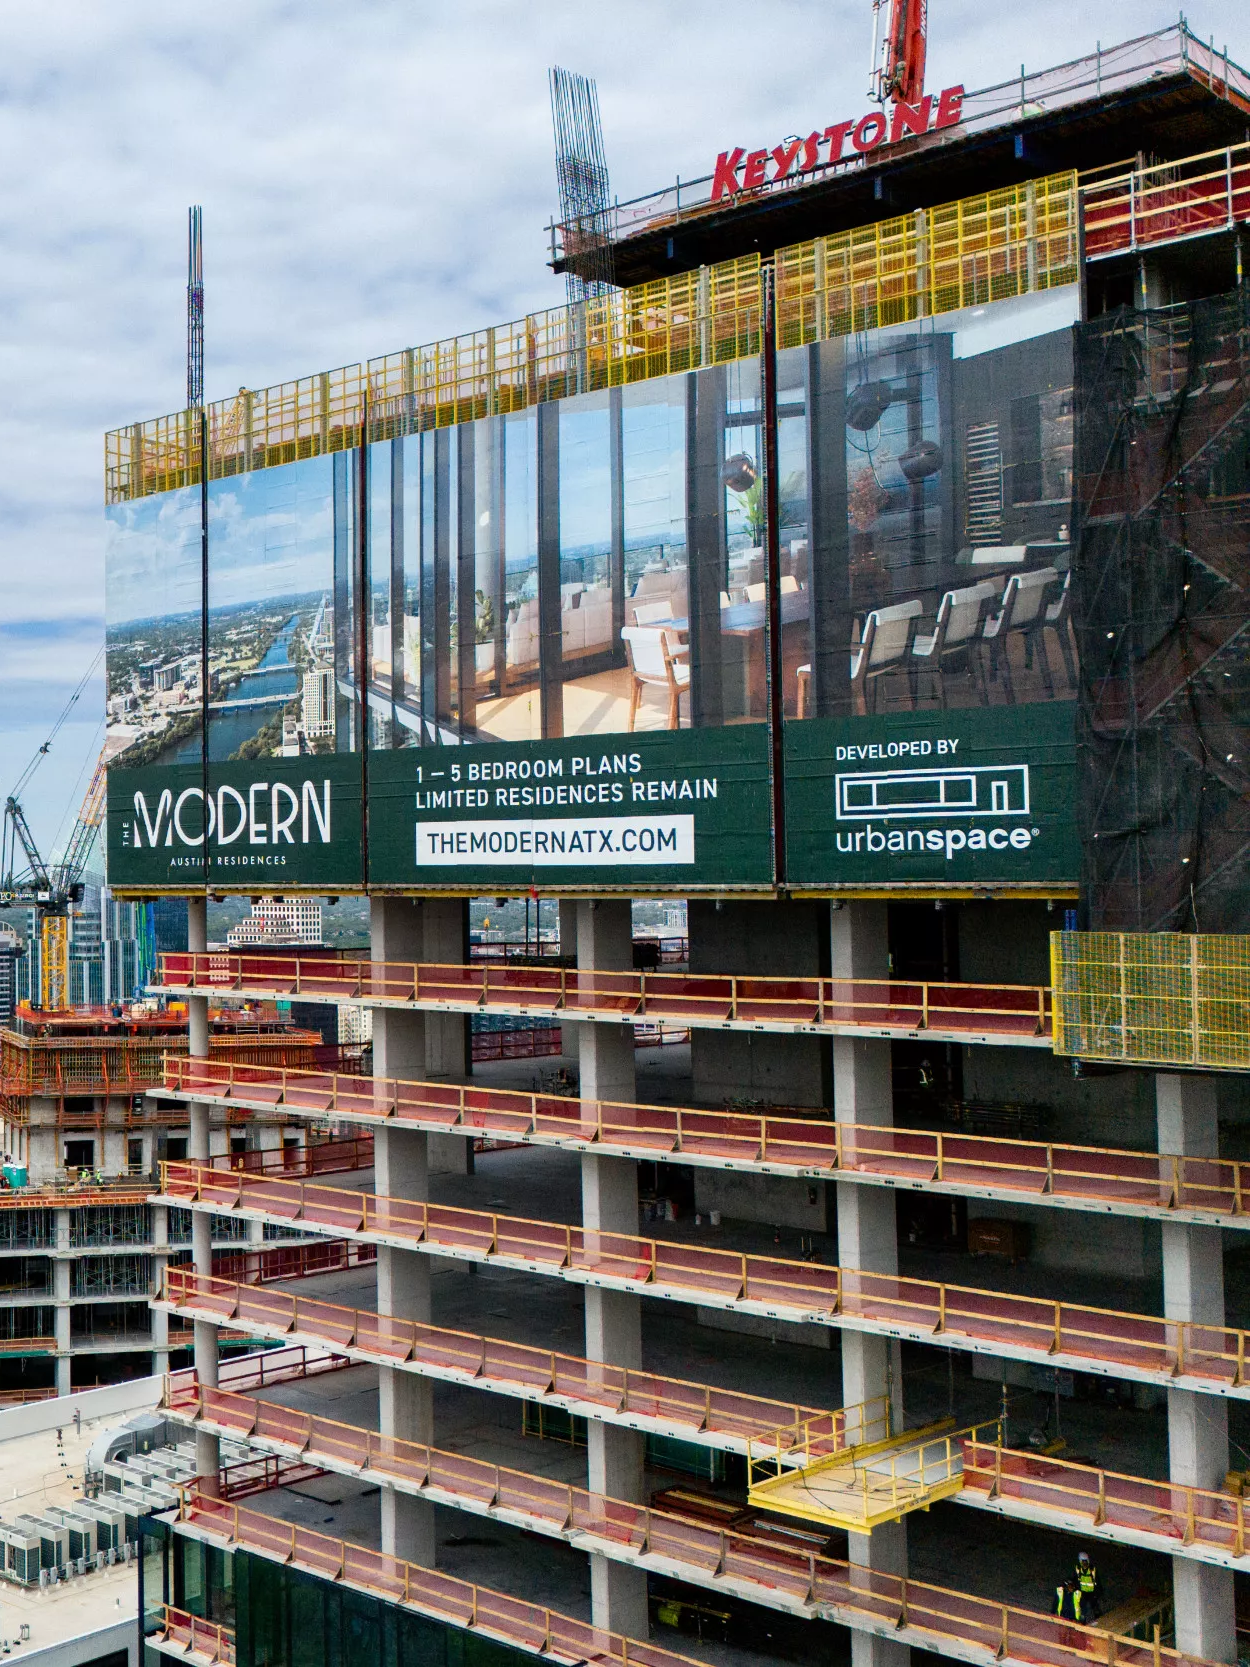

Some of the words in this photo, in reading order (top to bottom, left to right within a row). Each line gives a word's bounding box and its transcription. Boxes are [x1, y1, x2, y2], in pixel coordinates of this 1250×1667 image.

[710, 83, 965, 201] KEYSTONE
[836, 740, 932, 761] DEVELOPED
[937, 738, 959, 754] BY
[416, 766, 423, 783] 1
[451, 764, 461, 782] 5
[468, 758, 563, 782] BEDROOM
[571, 753, 642, 777] PLANS
[415, 788, 489, 809] LIMITED
[496, 783, 624, 807] RESIDENCES
[632, 778, 718, 801] REMAIN
[133, 779, 331, 848] MODERN
[427, 827, 677, 854] THEMODERNATX.COM
[217, 855, 287, 866] RESIDENCES
